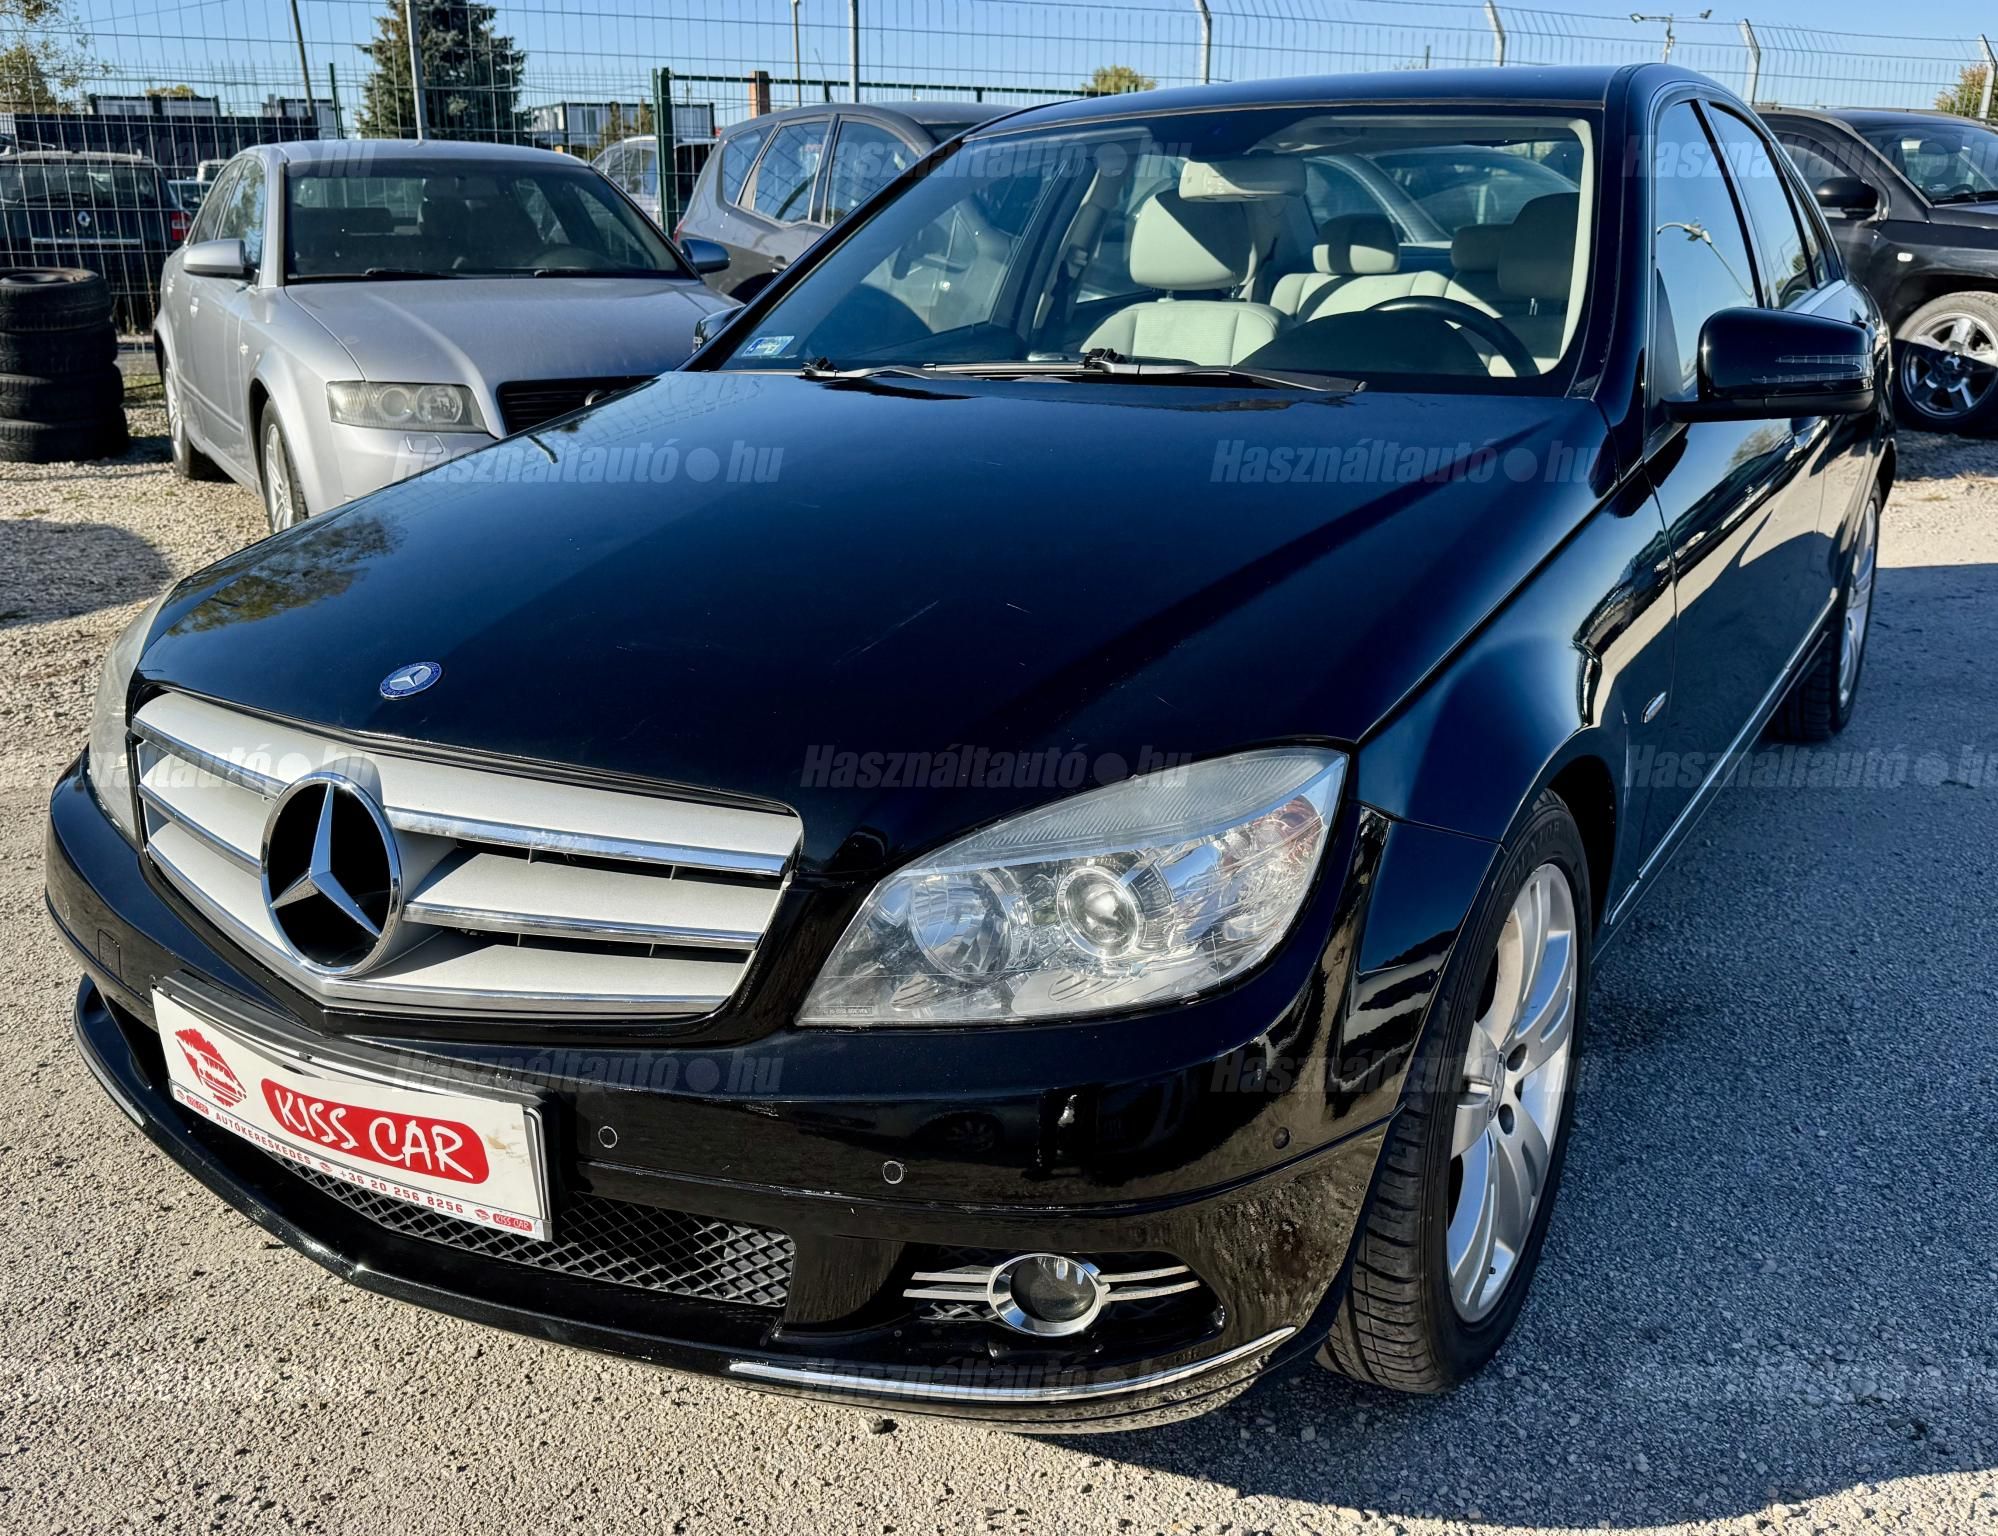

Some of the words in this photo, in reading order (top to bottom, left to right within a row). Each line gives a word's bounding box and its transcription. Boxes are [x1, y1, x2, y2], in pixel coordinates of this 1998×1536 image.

[274, 1089, 359, 1149] KISS
[369, 1116, 473, 1179] CAR
[340, 1171, 364, 1185] +36
[371, 1179, 387, 1192] 20
[394, 1186, 420, 1202] 256
[427, 1196, 464, 1214] 8256
[513, 1219, 529, 1230] CAR
